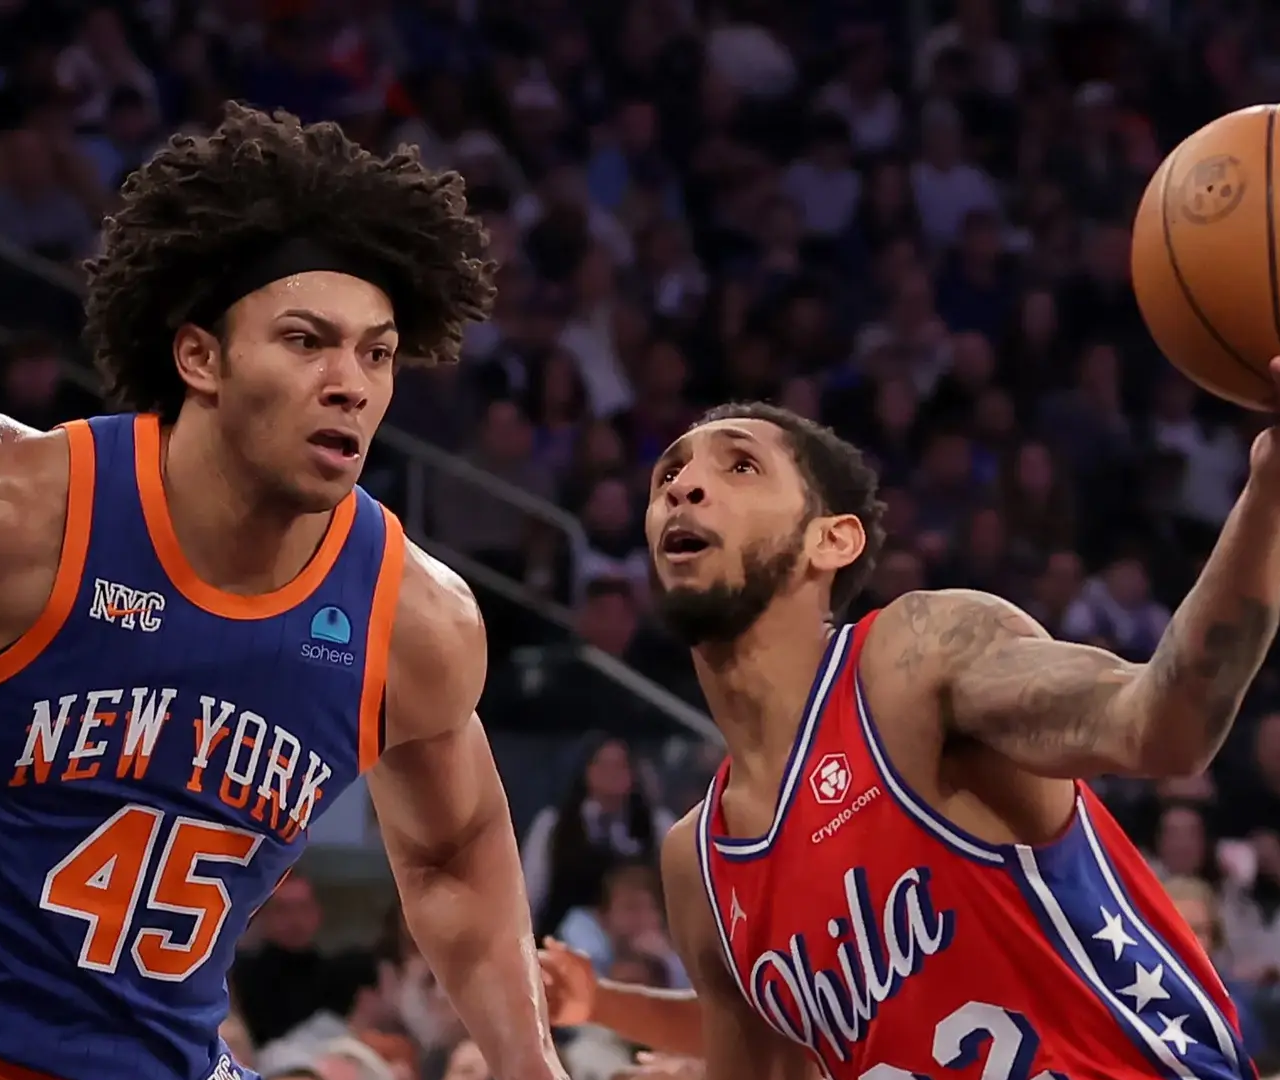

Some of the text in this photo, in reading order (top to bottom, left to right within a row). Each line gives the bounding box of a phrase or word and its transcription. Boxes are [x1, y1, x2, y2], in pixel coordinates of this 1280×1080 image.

[89, 578, 165, 631] NYC
[301, 644, 354, 666] sphere
[8, 687, 332, 842] NEW YORK
[811, 786, 881, 843] crypto.com
[39, 803, 266, 982] 45
[750, 867, 954, 1062] Phila
